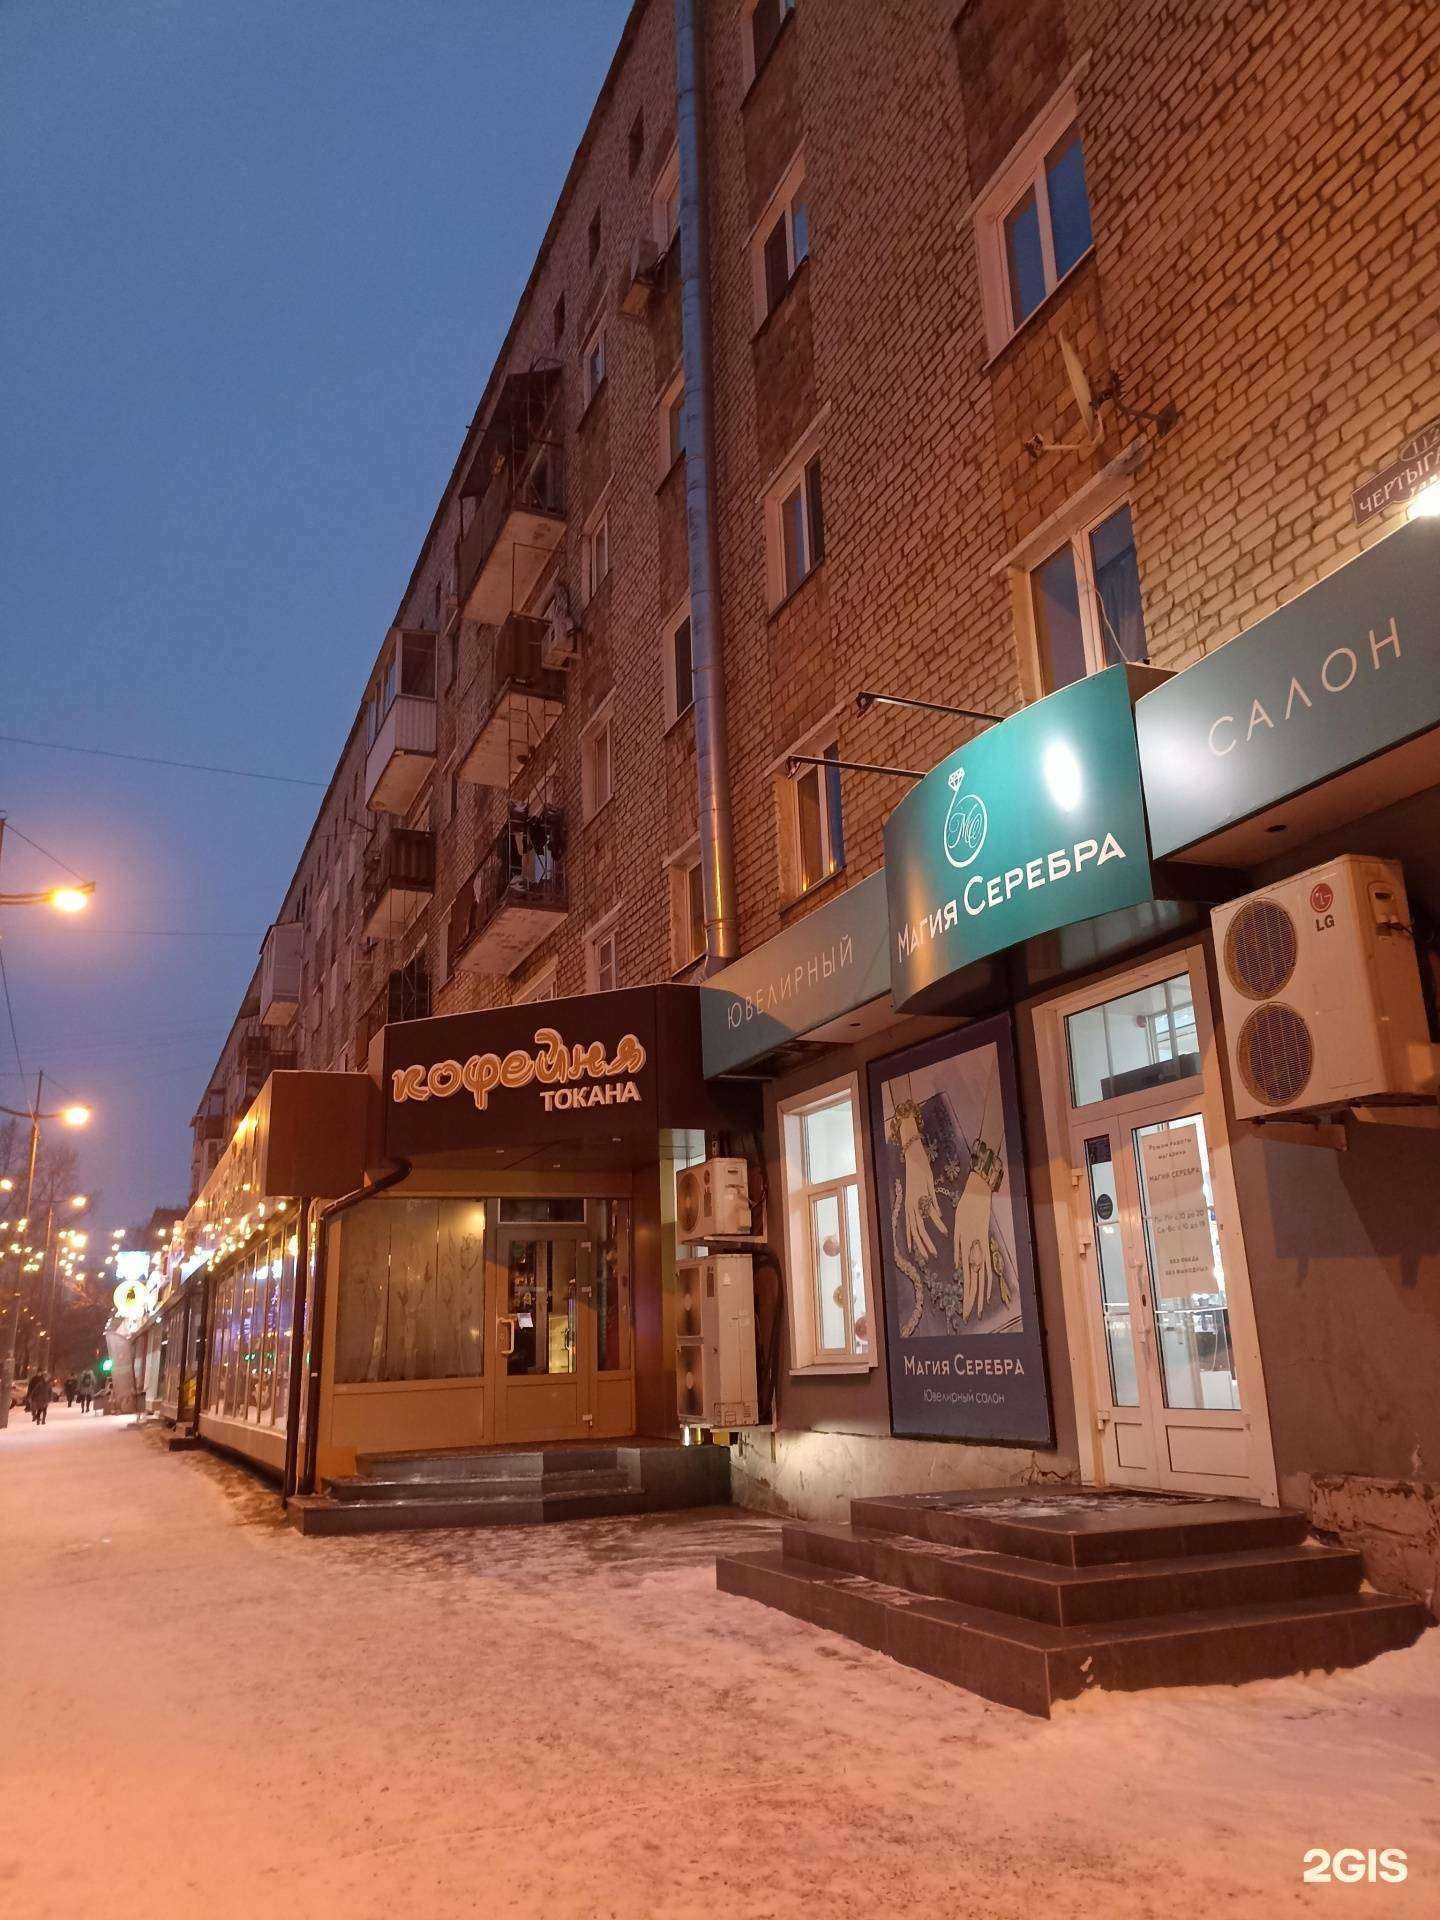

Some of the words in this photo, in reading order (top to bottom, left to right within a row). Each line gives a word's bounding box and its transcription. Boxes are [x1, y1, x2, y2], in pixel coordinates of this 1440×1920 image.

[1208, 616, 1401, 757] САЛОН
[1315, 914, 1335, 932] LG
[727, 934, 853, 1030] ЮВЕЛИРНЫЙ
[539, 1081, 643, 1112] ТОКАНА
